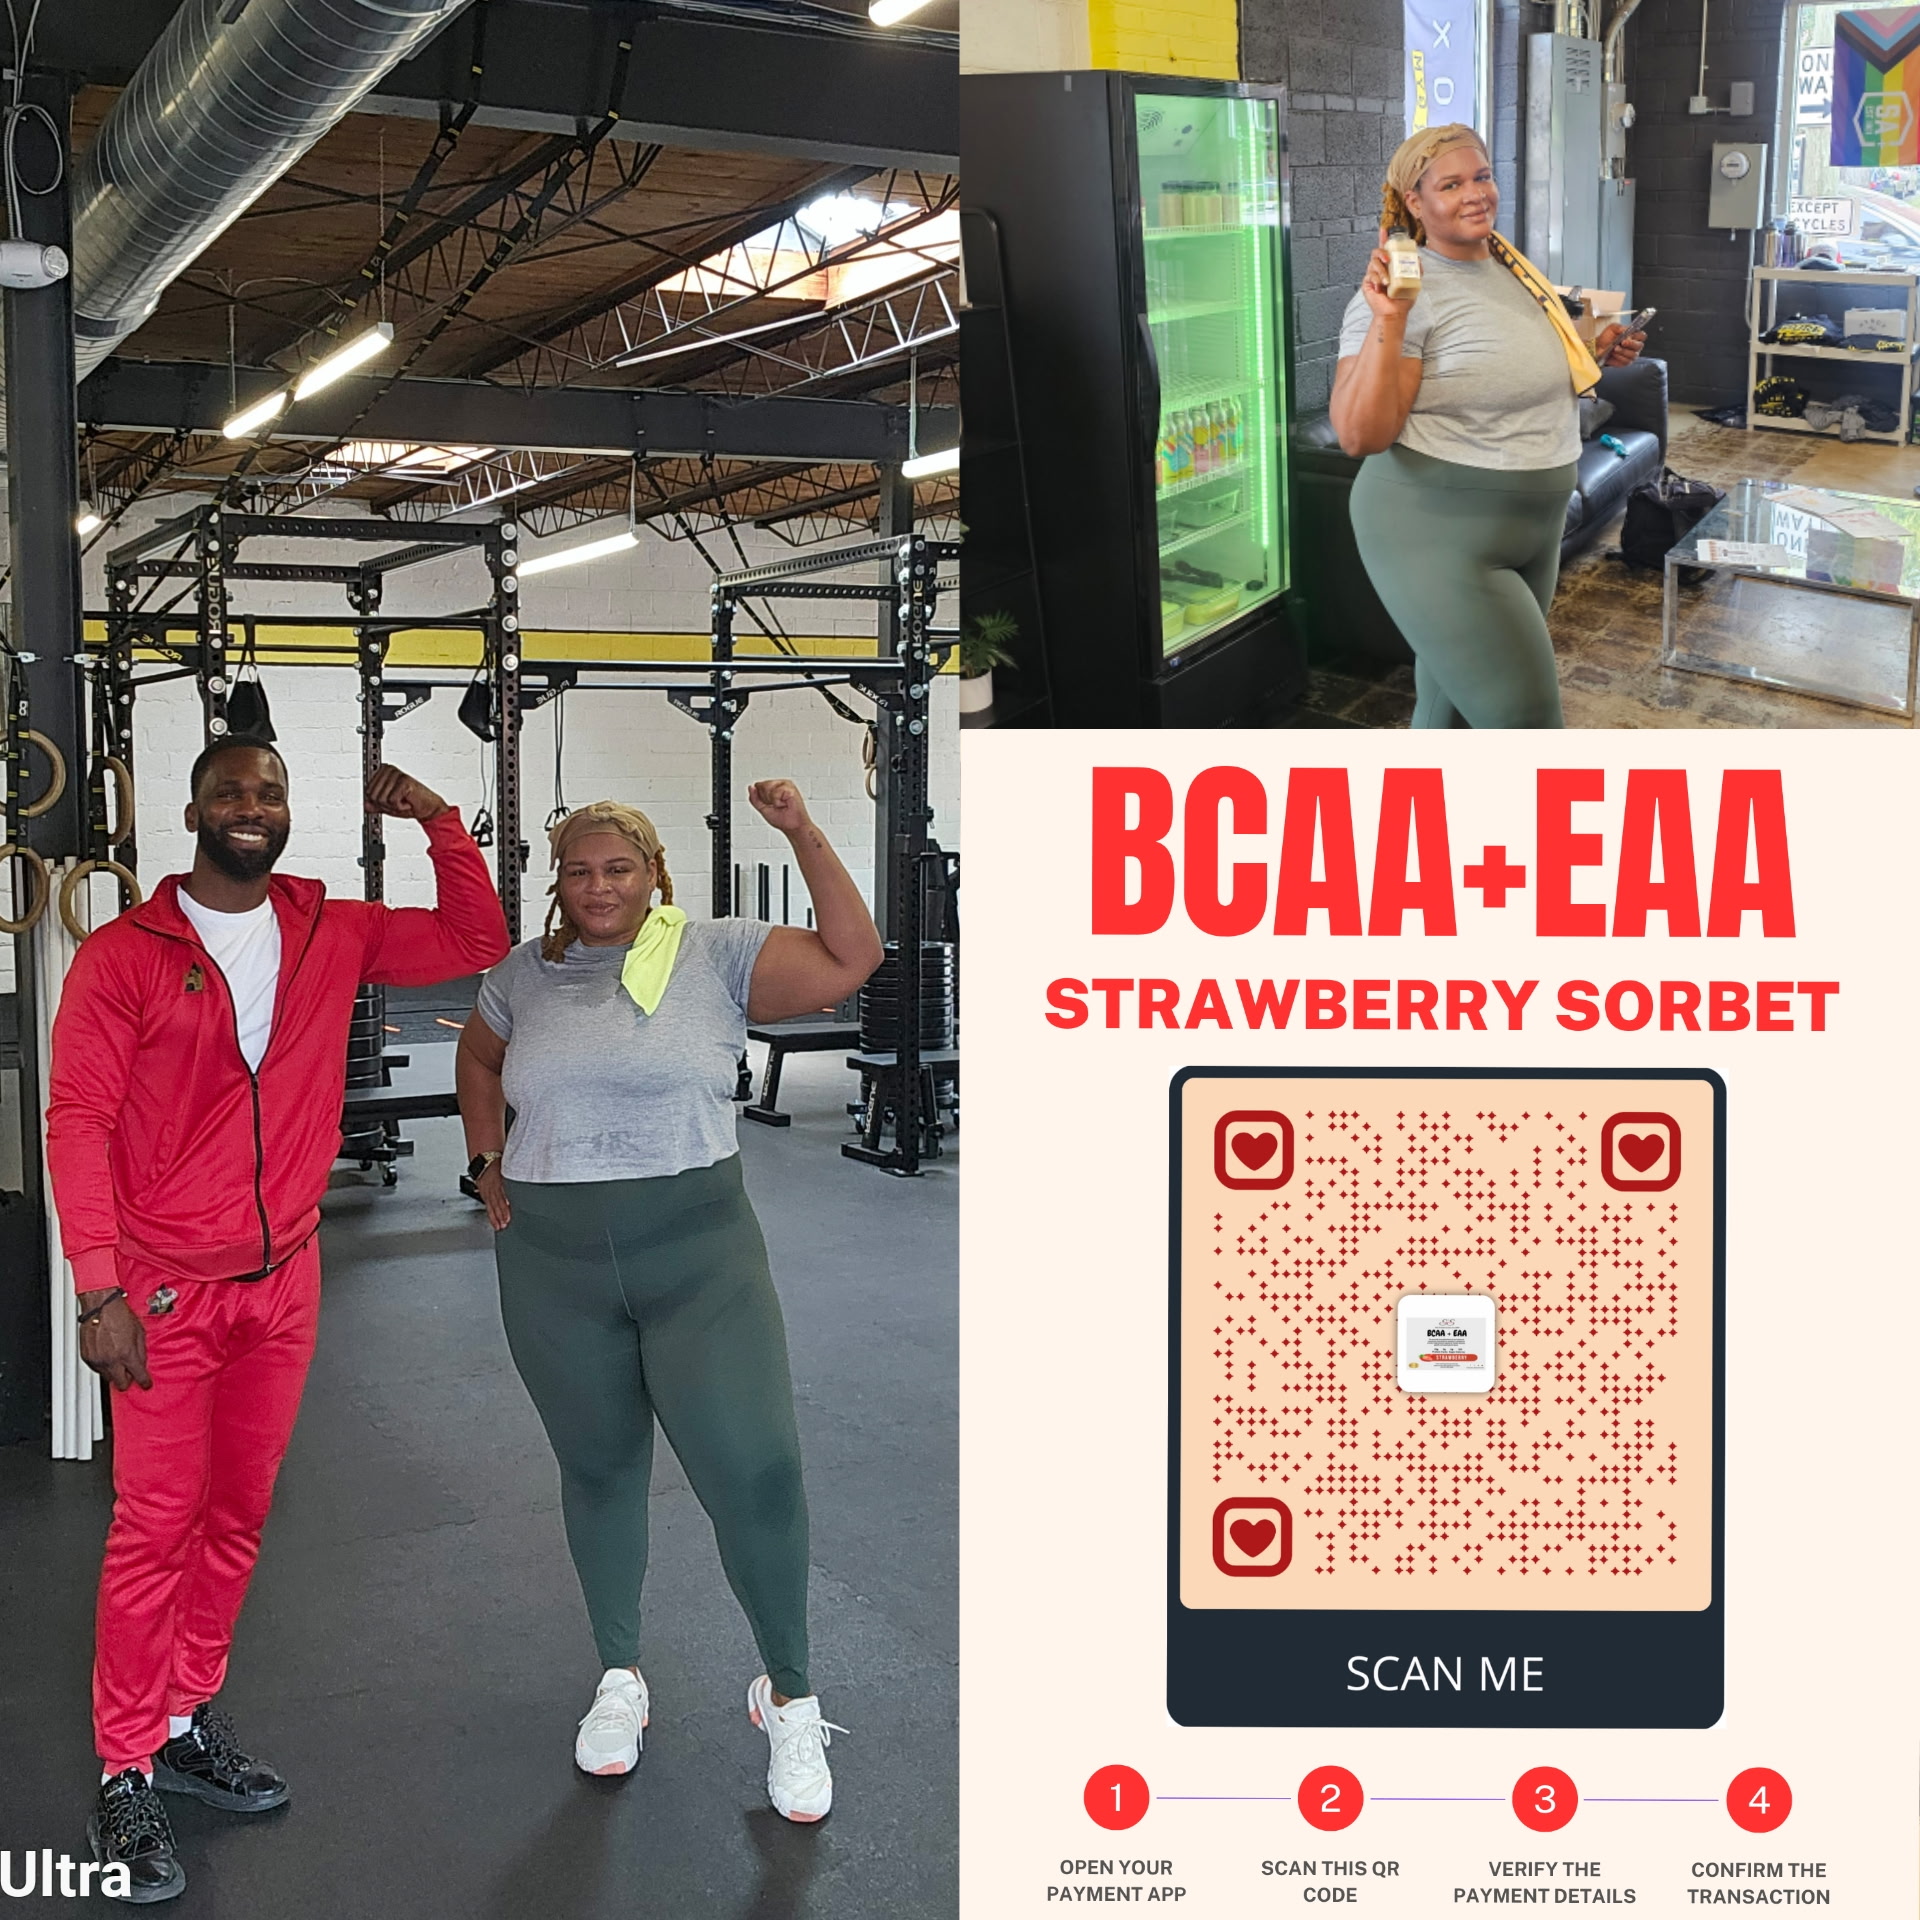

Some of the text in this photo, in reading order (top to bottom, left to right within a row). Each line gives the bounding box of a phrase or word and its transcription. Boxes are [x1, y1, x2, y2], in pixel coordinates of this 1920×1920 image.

[1801, 53, 1830, 73] ON
[1799, 76, 1834, 95] WA
[1790, 201, 1839, 214] EXCEPT
[1793, 217, 1846, 231] CYCLES
[393, 696, 425, 718] ROGUE
